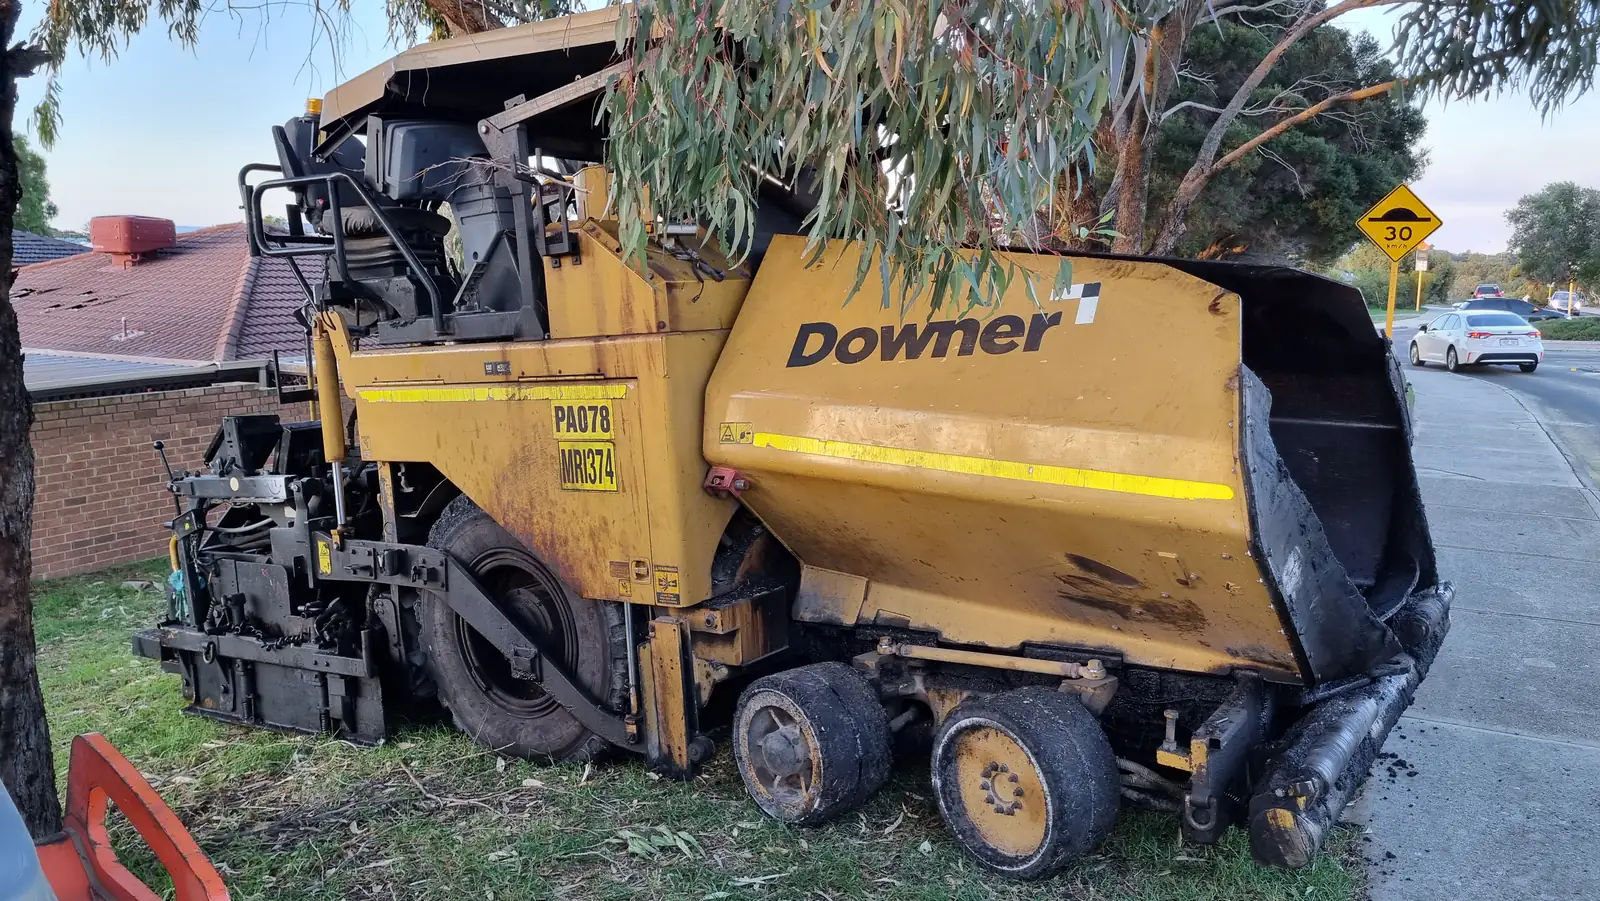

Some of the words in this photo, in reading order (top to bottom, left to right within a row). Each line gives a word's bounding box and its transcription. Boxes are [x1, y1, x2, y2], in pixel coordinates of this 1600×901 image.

[1384, 226, 1412, 241] 30
[786, 310, 1063, 368] Downer
[554, 405, 610, 433] PA078
